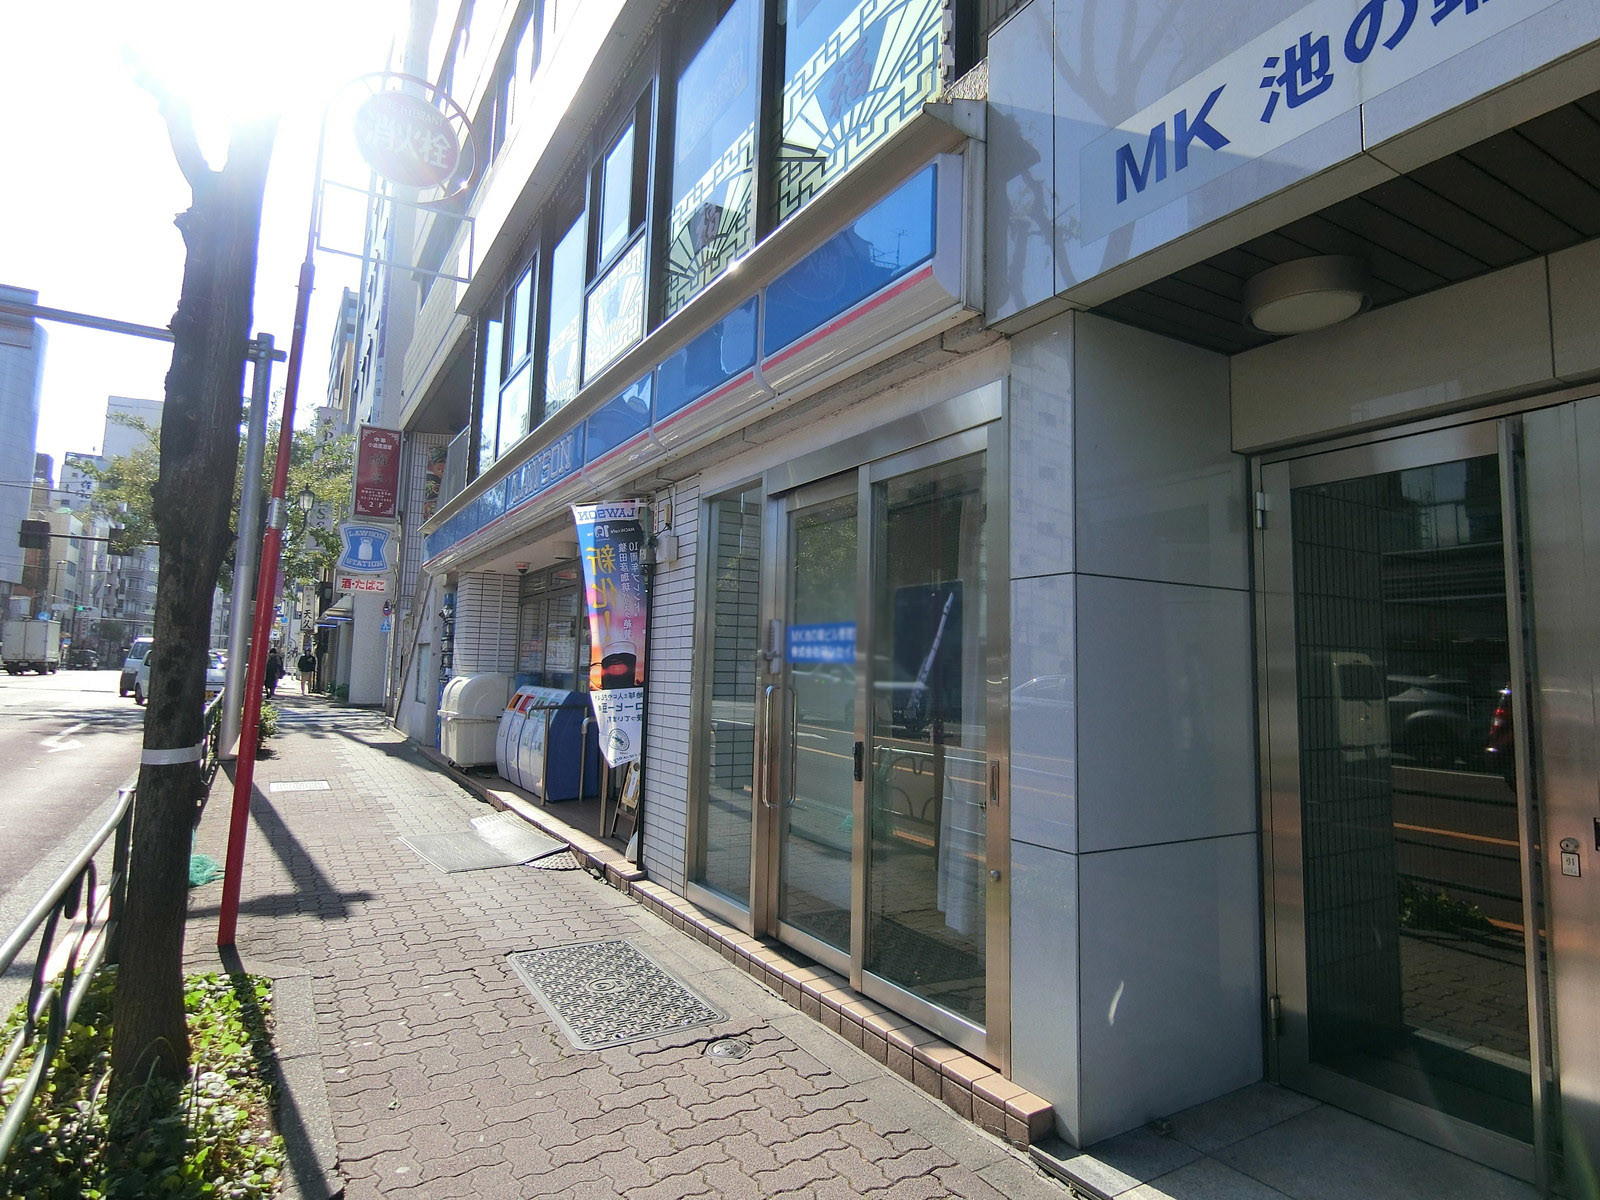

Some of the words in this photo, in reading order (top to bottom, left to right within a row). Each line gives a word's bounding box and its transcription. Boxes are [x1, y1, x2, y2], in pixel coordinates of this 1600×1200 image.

[400, 104, 444, 126] HYDRANT
[362, 111, 451, 169] 消火栓
[1116, 83, 1231, 204] MK
[348, 530, 386, 540] LAWSON
[345, 557, 384, 567] STATION
